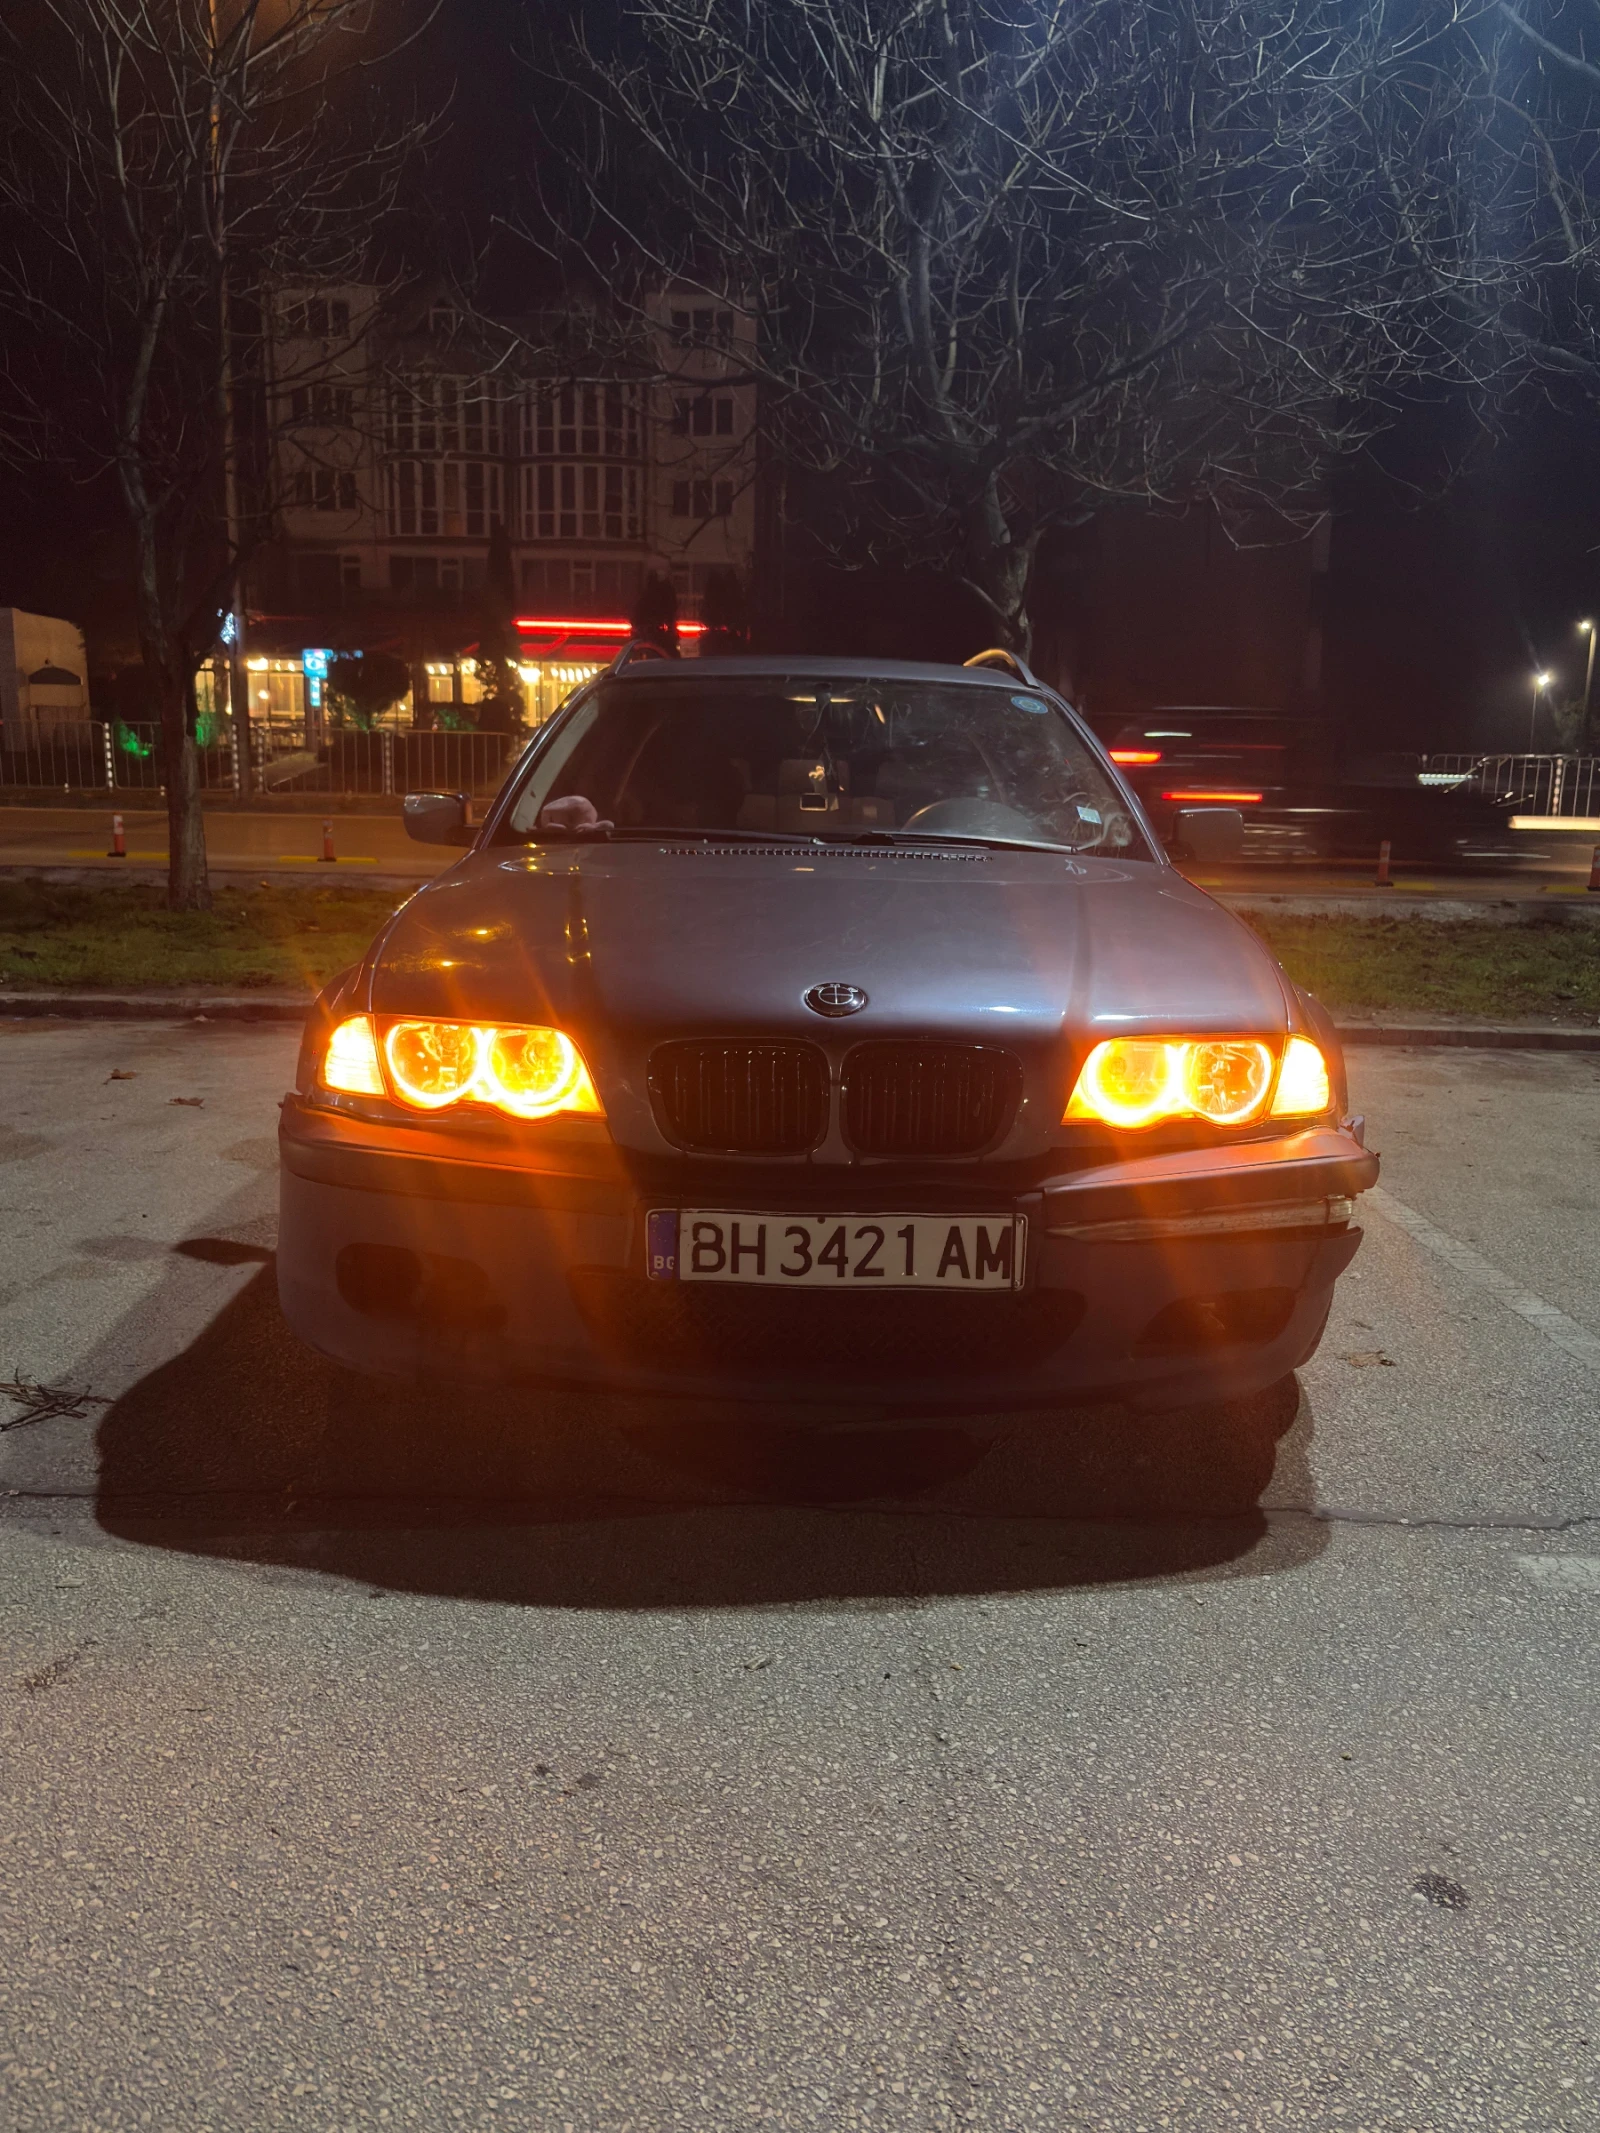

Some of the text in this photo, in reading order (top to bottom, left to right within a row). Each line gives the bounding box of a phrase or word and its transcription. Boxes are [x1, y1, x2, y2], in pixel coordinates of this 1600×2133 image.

[691, 1221, 1012, 1280] BH 3421 AM
